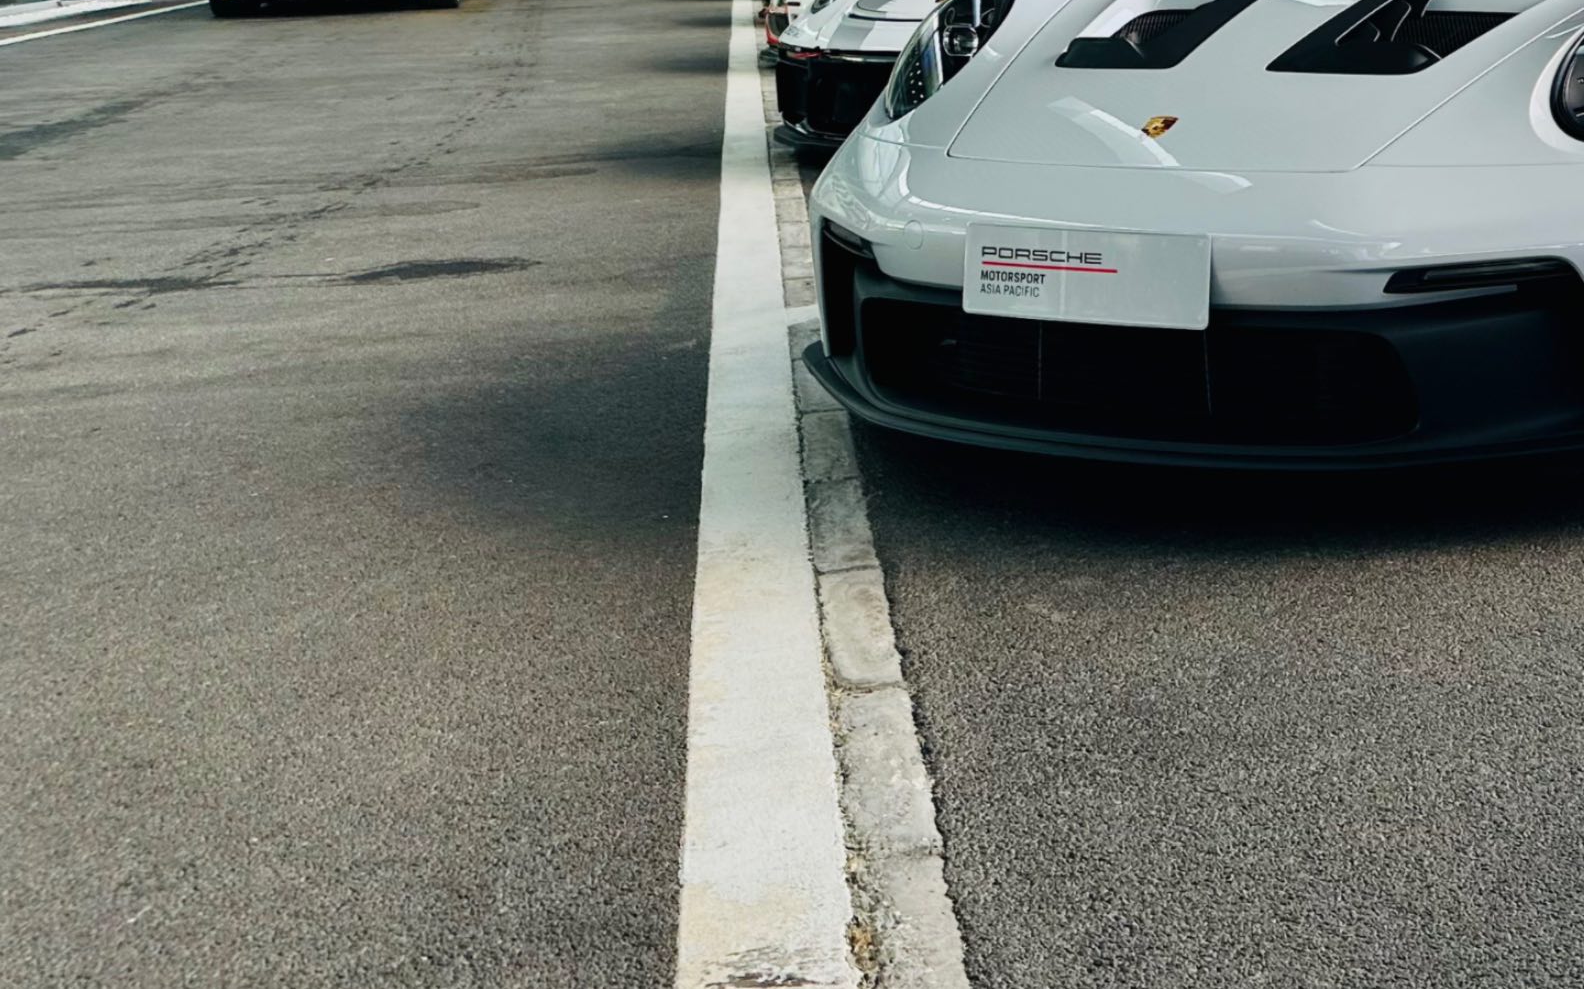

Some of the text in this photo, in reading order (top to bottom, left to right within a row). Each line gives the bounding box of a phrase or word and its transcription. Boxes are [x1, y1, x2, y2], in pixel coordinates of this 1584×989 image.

[981, 246, 1103, 265] PORSCHE
[980, 270, 1046, 285] MOTORSPORT
[980, 283, 1040, 298] ASIA PACIFIC
